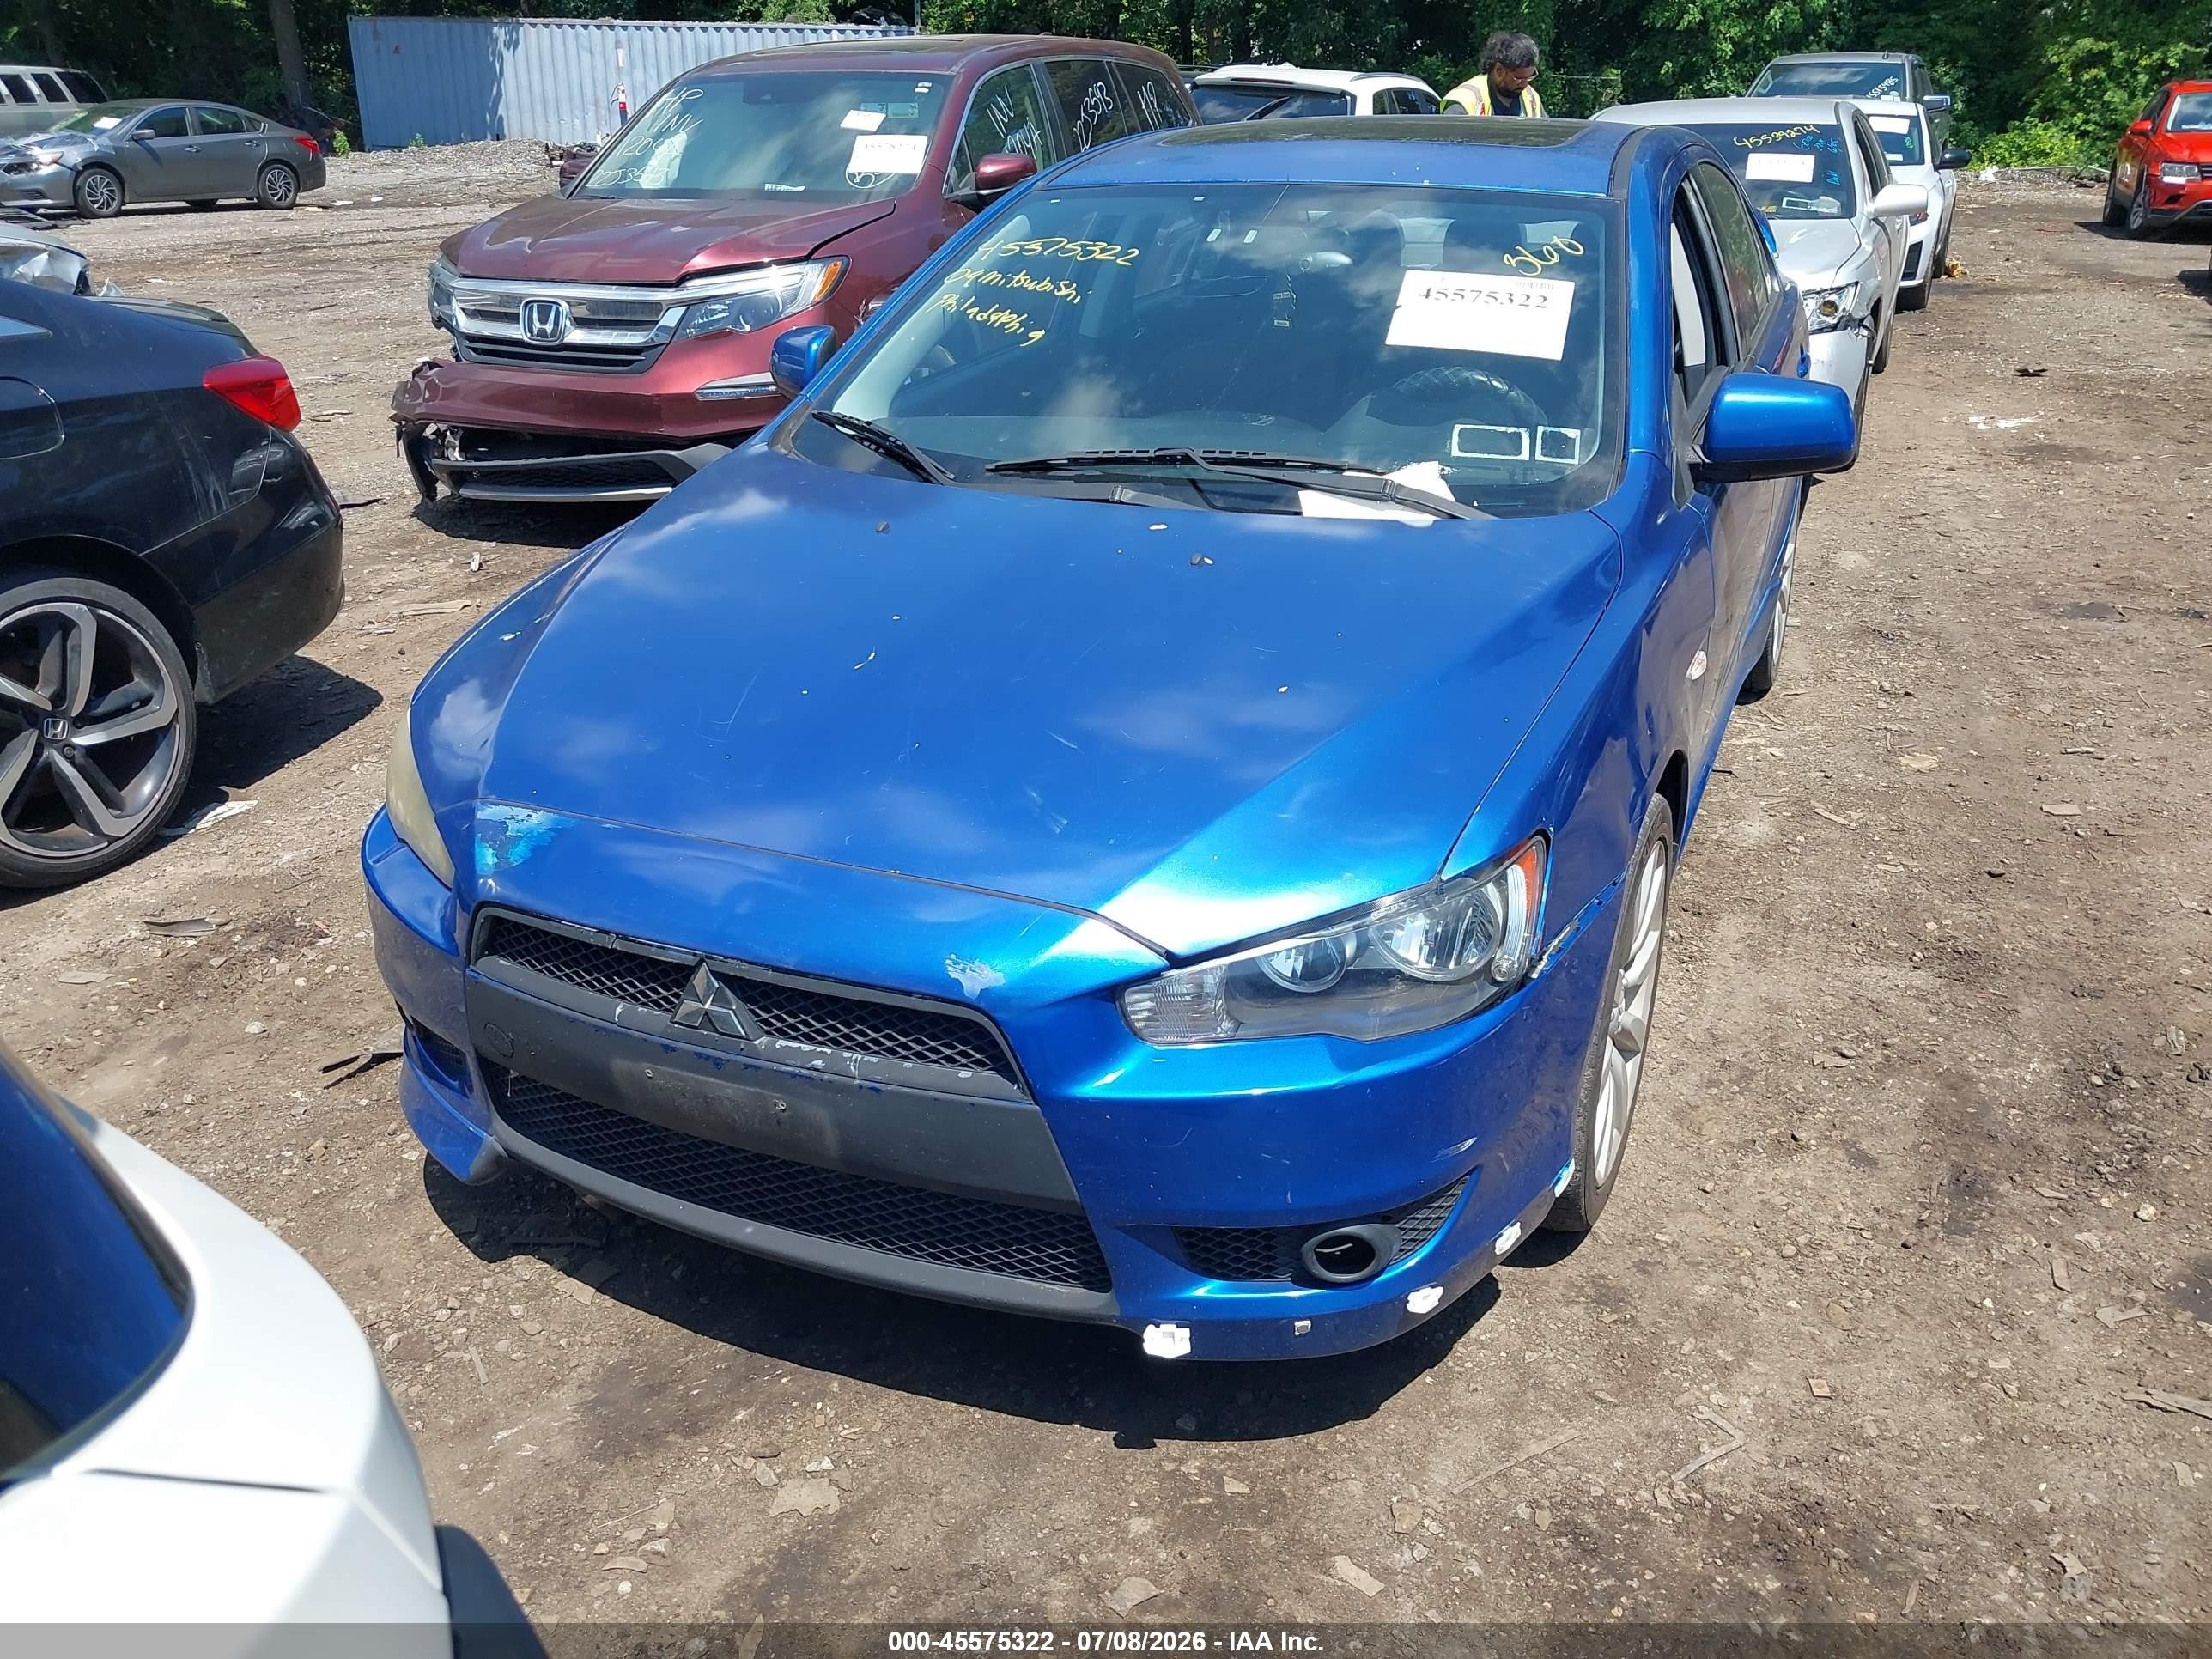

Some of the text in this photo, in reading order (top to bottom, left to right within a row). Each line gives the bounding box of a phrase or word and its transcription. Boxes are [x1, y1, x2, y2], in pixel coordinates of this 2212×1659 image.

[1733, 125, 1821, 149] 45539274
[979, 237, 1140, 267] 45575322
[1417, 287, 1549, 309] 45575322
